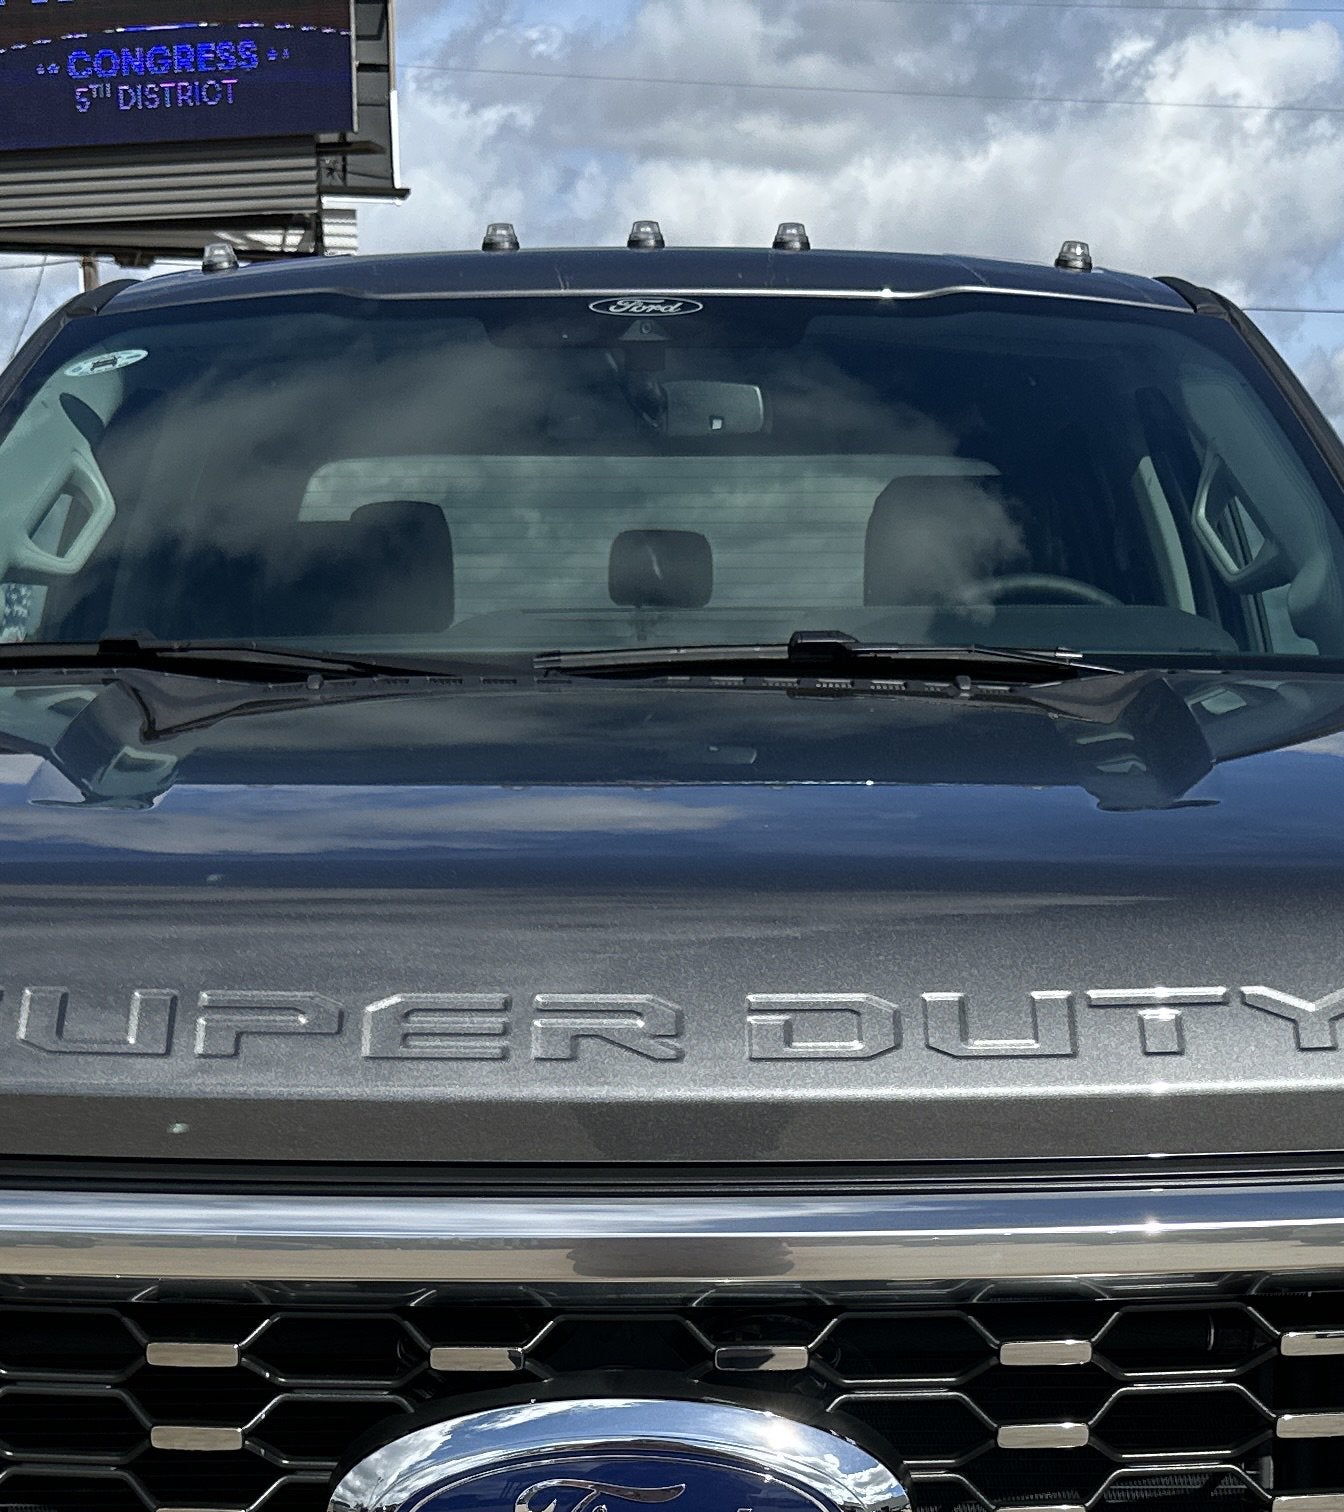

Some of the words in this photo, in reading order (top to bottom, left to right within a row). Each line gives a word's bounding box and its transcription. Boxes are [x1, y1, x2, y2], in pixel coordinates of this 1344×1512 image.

[66, 40, 259, 79] CONGRESS
[118, 79, 239, 111] DISTRICT
[608, 298, 683, 313] Ford
